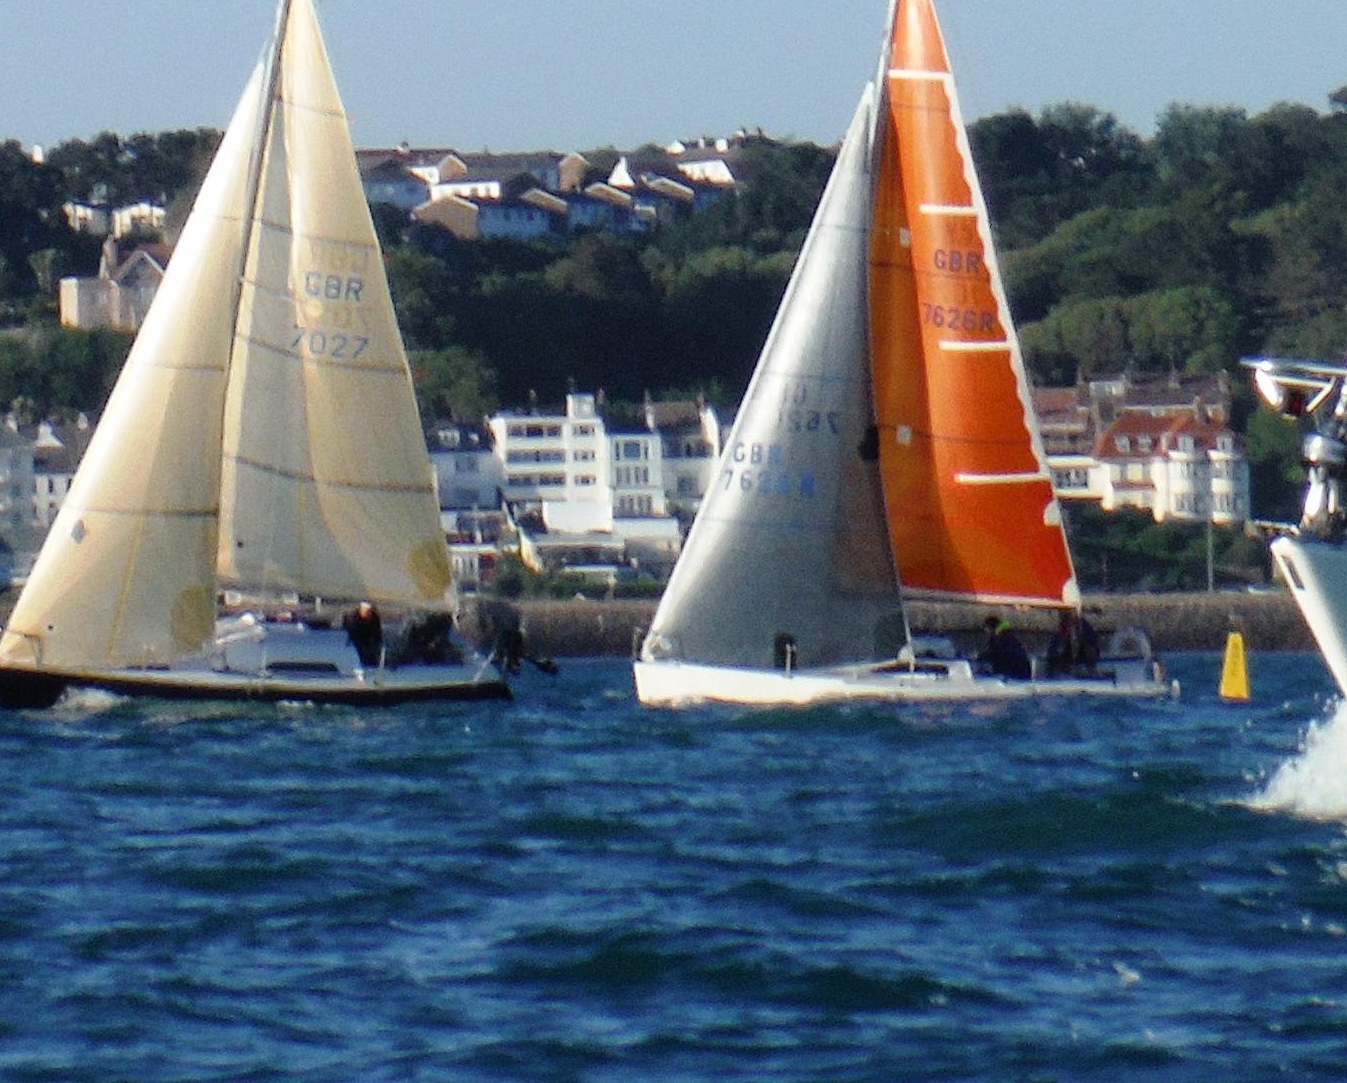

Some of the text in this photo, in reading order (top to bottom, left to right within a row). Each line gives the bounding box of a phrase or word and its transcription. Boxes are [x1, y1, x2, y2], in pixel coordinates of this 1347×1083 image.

[934, 249, 981, 273] GBR
[305, 271, 364, 301] GBR
[292, 329, 369, 359] 7027
